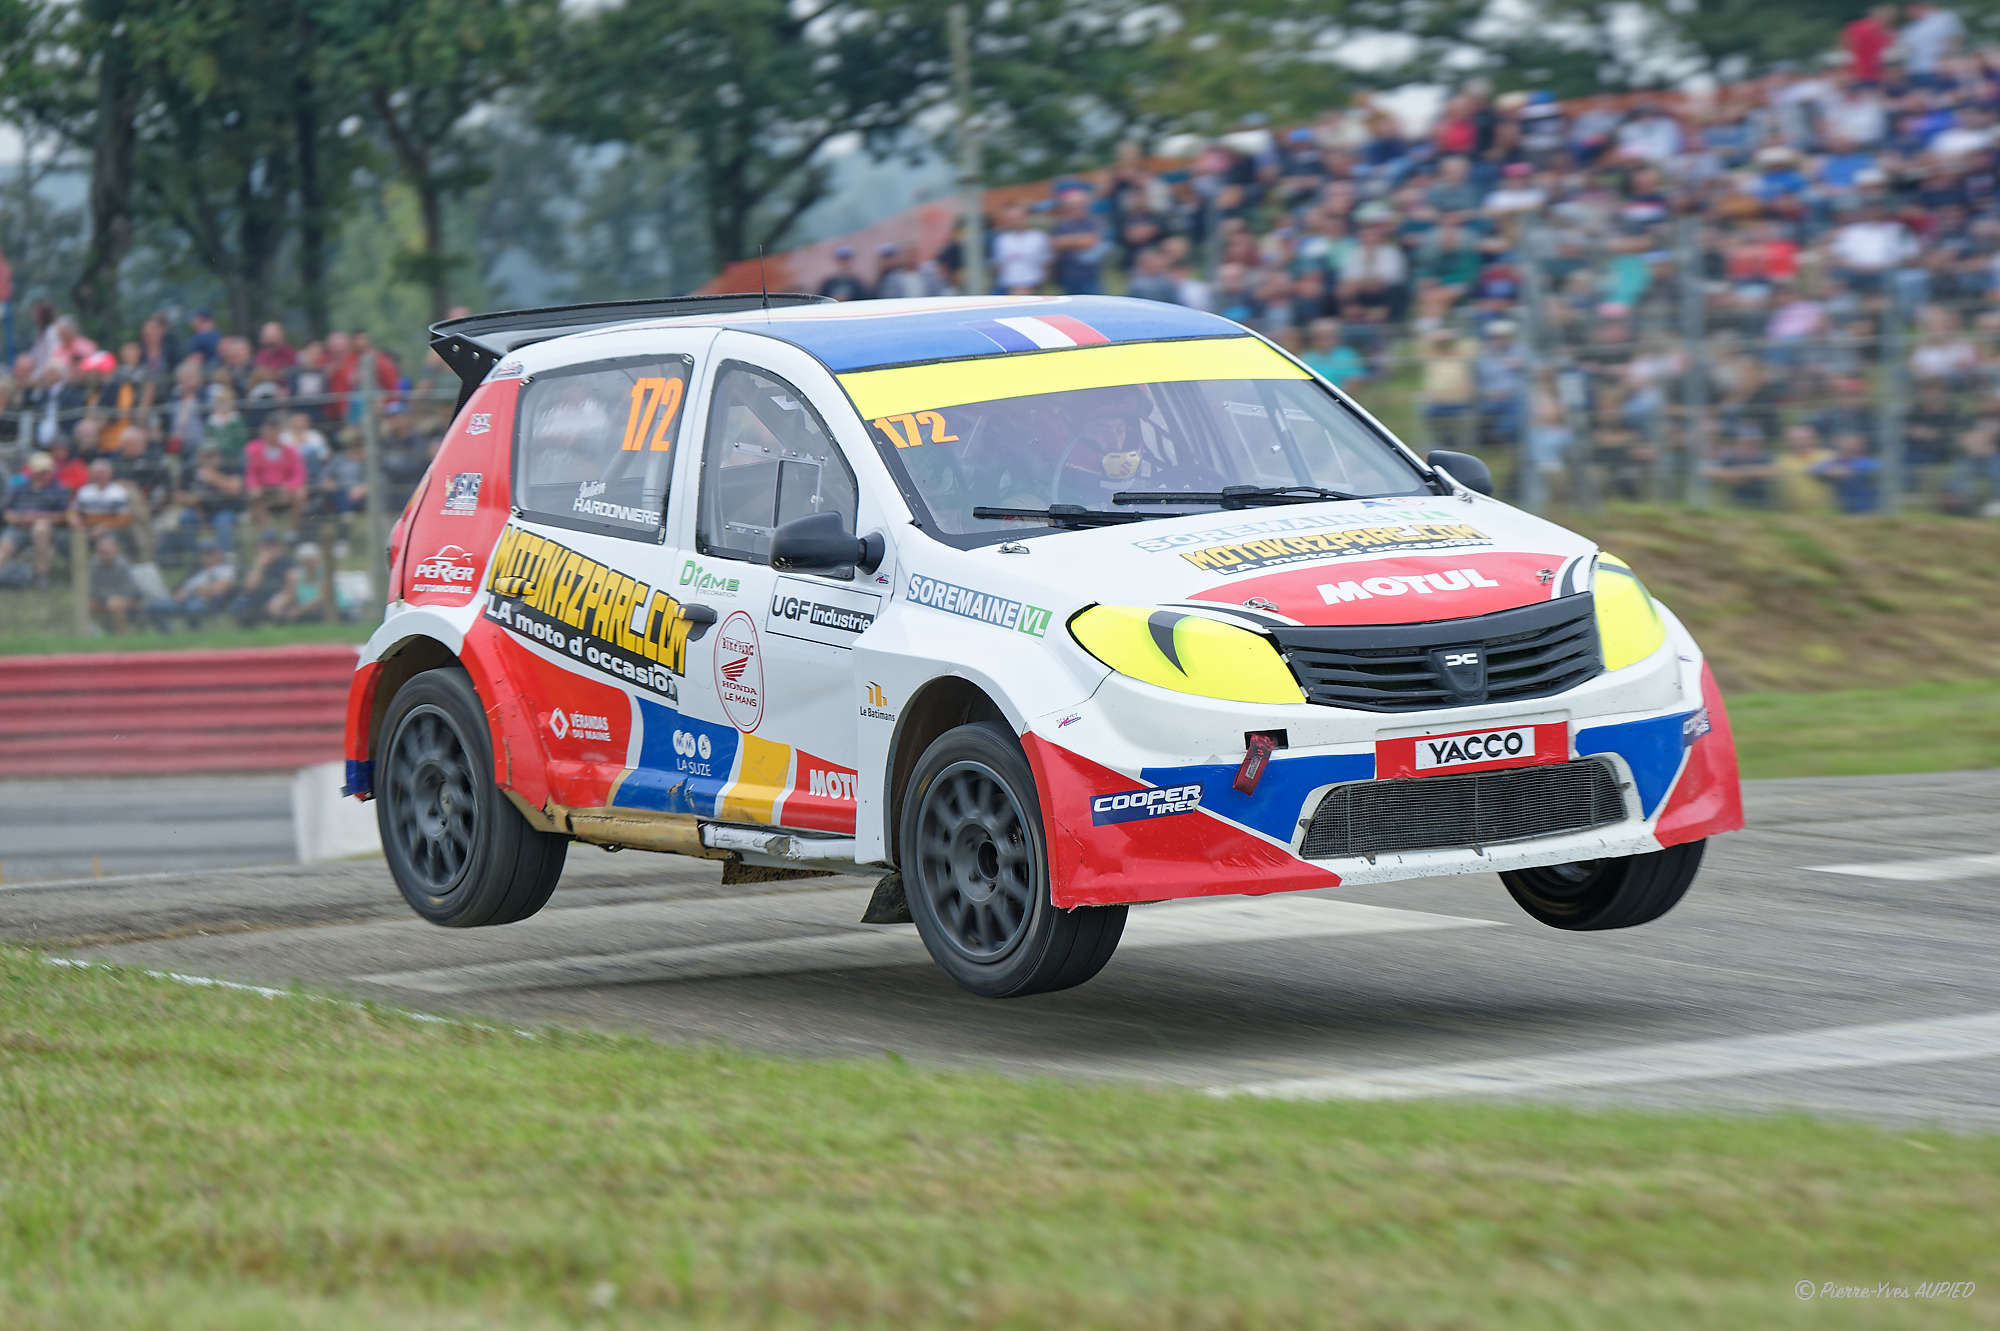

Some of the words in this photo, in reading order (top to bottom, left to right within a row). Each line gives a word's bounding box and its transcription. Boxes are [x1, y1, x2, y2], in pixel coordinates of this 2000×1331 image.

[623, 377, 683, 452] 172
[873, 410, 959, 449] 172
[1180, 521, 1492, 570] MOTOKAZPARC.COM
[1217, 563, 1260, 574] LA
[1263, 551, 1337, 566] moto
[1317, 568, 1499, 606] MOTUL
[772, 595, 811, 622] UGF
[908, 575, 1021, 630] SOREMAINE
[1021, 605, 1050, 636] VL
[486, 593, 513, 624] LA
[515, 612, 566, 650] moto
[722, 680, 757, 695] HONDA
[724, 691, 734, 701] LE
[735, 694, 757, 707] MANS
[859, 705, 867, 717] Le
[1428, 731, 1523, 765] YACCO
[676, 758, 688, 771] LA
[688, 761, 712, 777] SUZE
[1094, 784, 1202, 812] COOPER
[1146, 799, 1199, 816] TIRES
